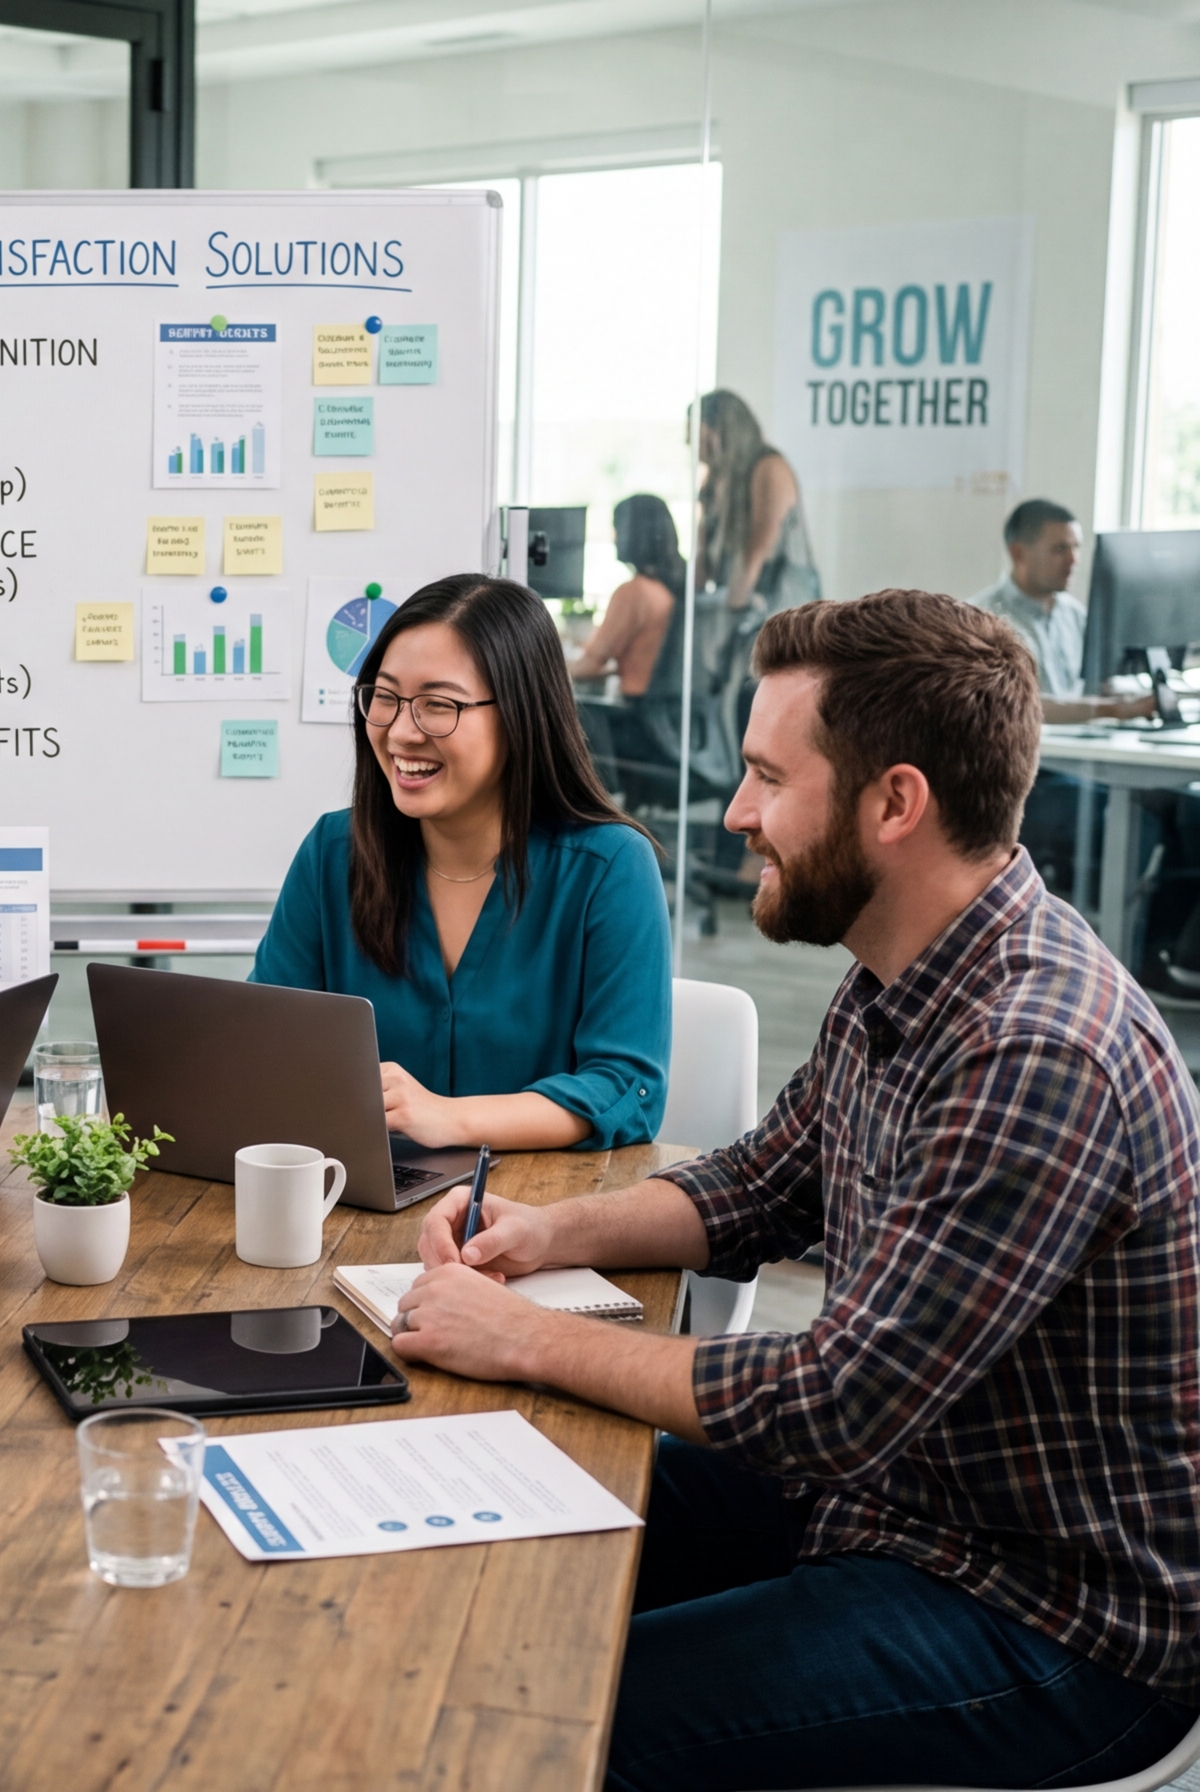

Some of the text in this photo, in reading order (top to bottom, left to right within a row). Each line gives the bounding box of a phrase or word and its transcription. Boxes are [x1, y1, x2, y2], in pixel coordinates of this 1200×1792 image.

[206, 230, 405, 278] SOLUTIONS
[811, 281, 993, 369] GROW
[807, 377, 989, 427] TOGETHER
